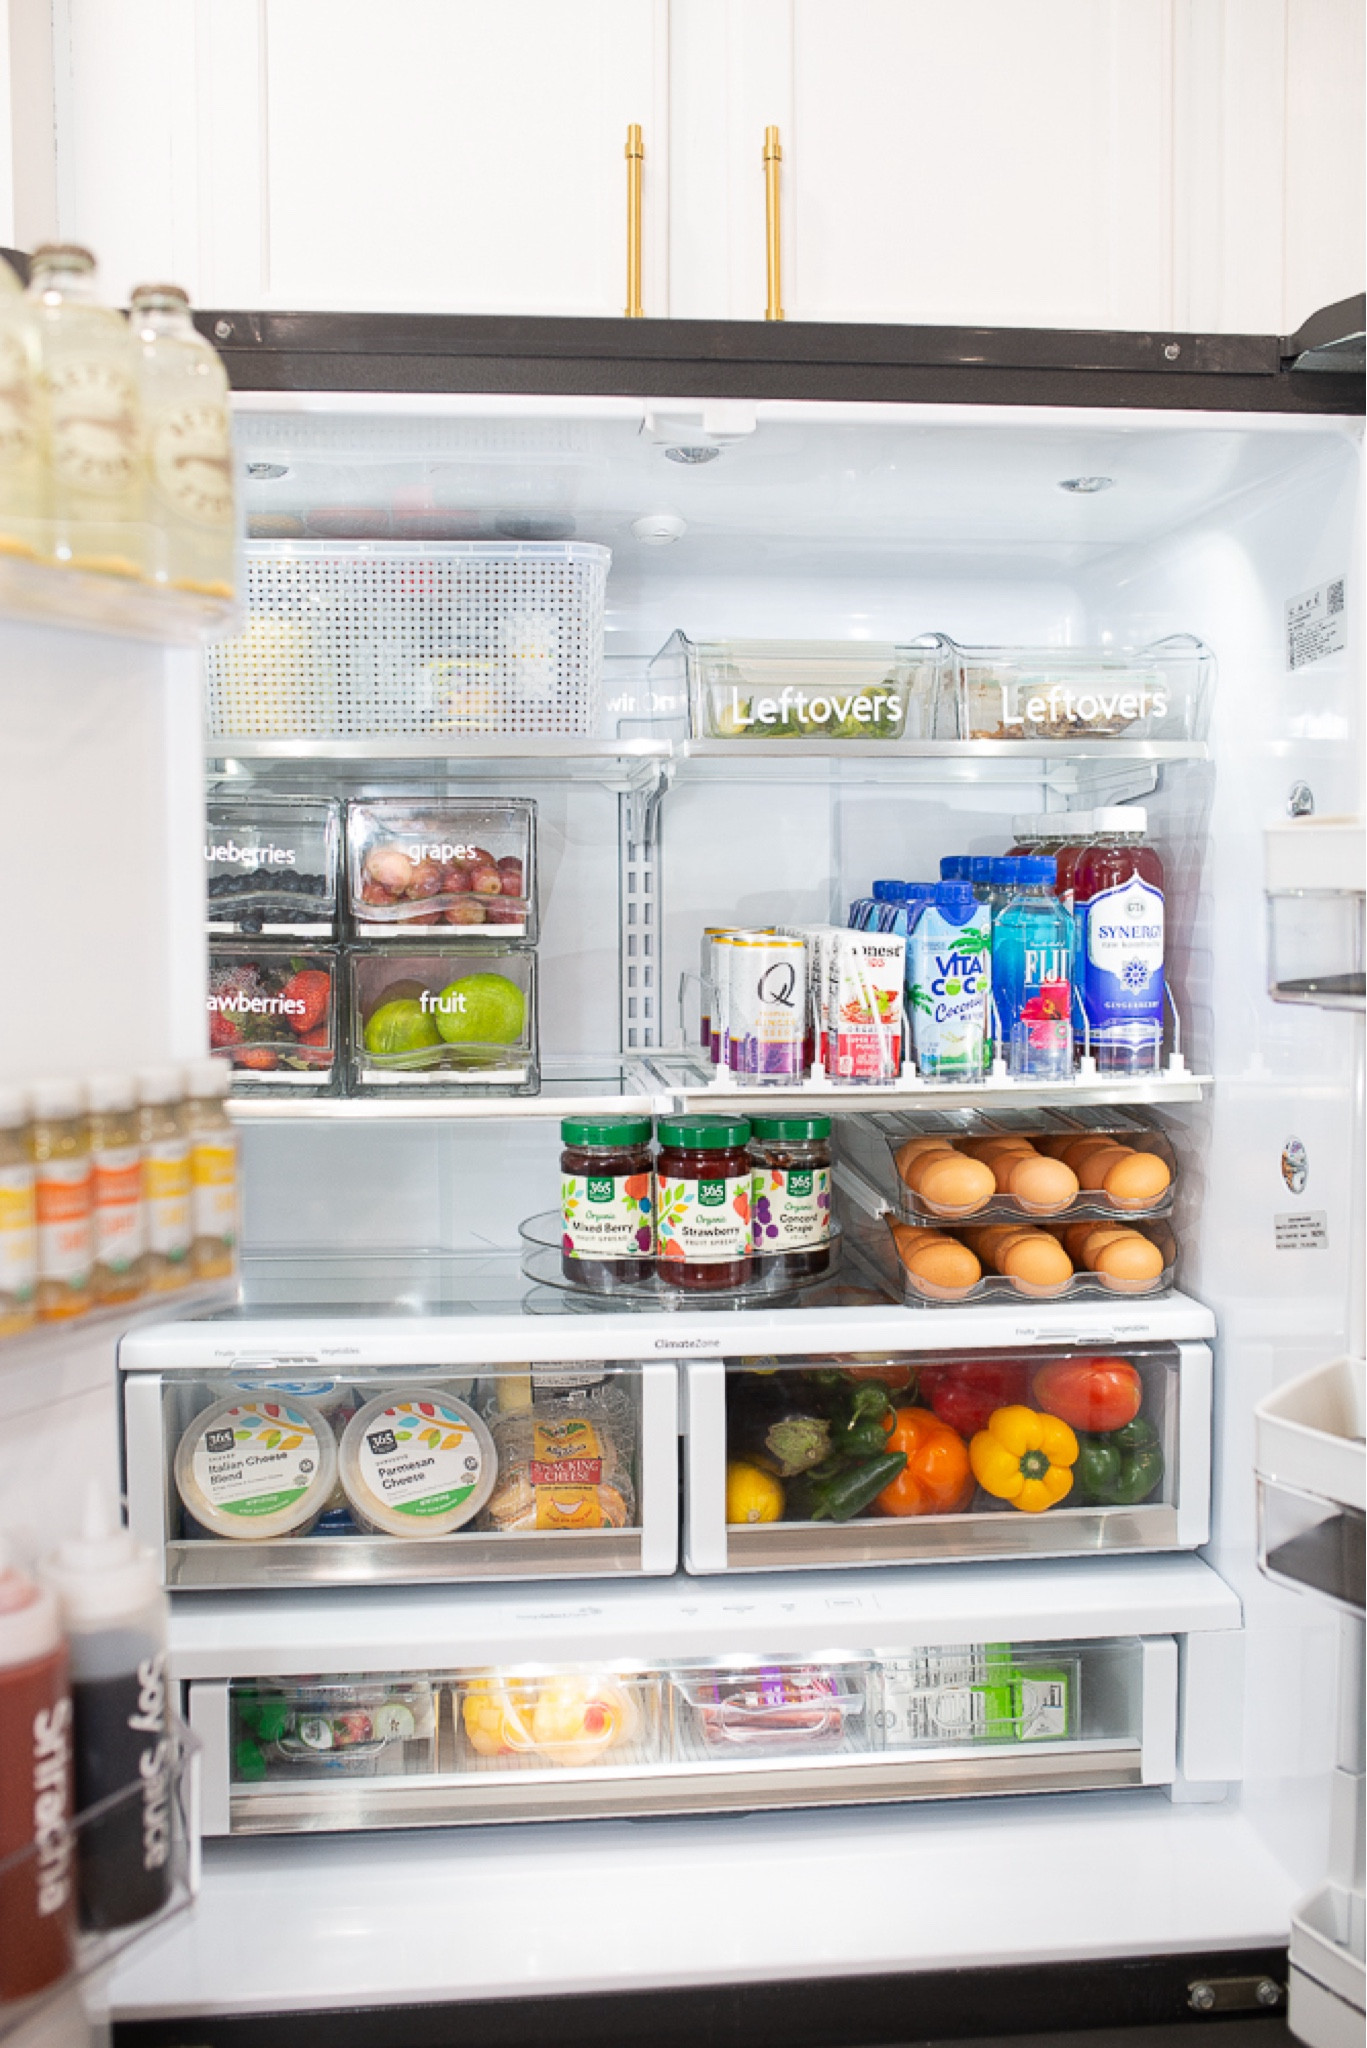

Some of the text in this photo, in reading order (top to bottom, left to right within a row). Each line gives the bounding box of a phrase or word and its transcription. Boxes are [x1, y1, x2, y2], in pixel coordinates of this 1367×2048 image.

[731, 686, 902, 725] Leftovers
[1003, 685, 1168, 724] Leftovers
[204, 840, 296, 865] ueberries
[408, 842, 477, 865] grapes
[1098, 924, 1161, 939] SYNERG
[935, 952, 984, 977] VITA
[1024, 948, 1071, 985] FIJI
[757, 962, 795, 1008] Q
[931, 976, 988, 996] COCO
[206, 990, 306, 1015] awberries
[419, 990, 467, 1014] fruit
[589, 1181, 611, 1195] 365
[700, 1184, 724, 1197] 365
[789, 1175, 812, 1189] 365
[573, 1222, 633, 1234] Mixed Berry
[695, 1214, 727, 1225] Organic
[784, 1224, 814, 1234] Grape
[681, 1226, 740, 1237] Strawberry
[208, 1431, 232, 1445] 365
[372, 1432, 394, 1448] 365
[208, 1460, 244, 1474] Italian
[245, 1451, 288, 1466] Cheese
[378, 1456, 435, 1478] Parmesan
[210, 1470, 243, 1486] Blend
[382, 1472, 426, 1490] Cheese
[128, 1653, 171, 1870] Soy Sauce
[34, 1698, 73, 1916] Sriracha
